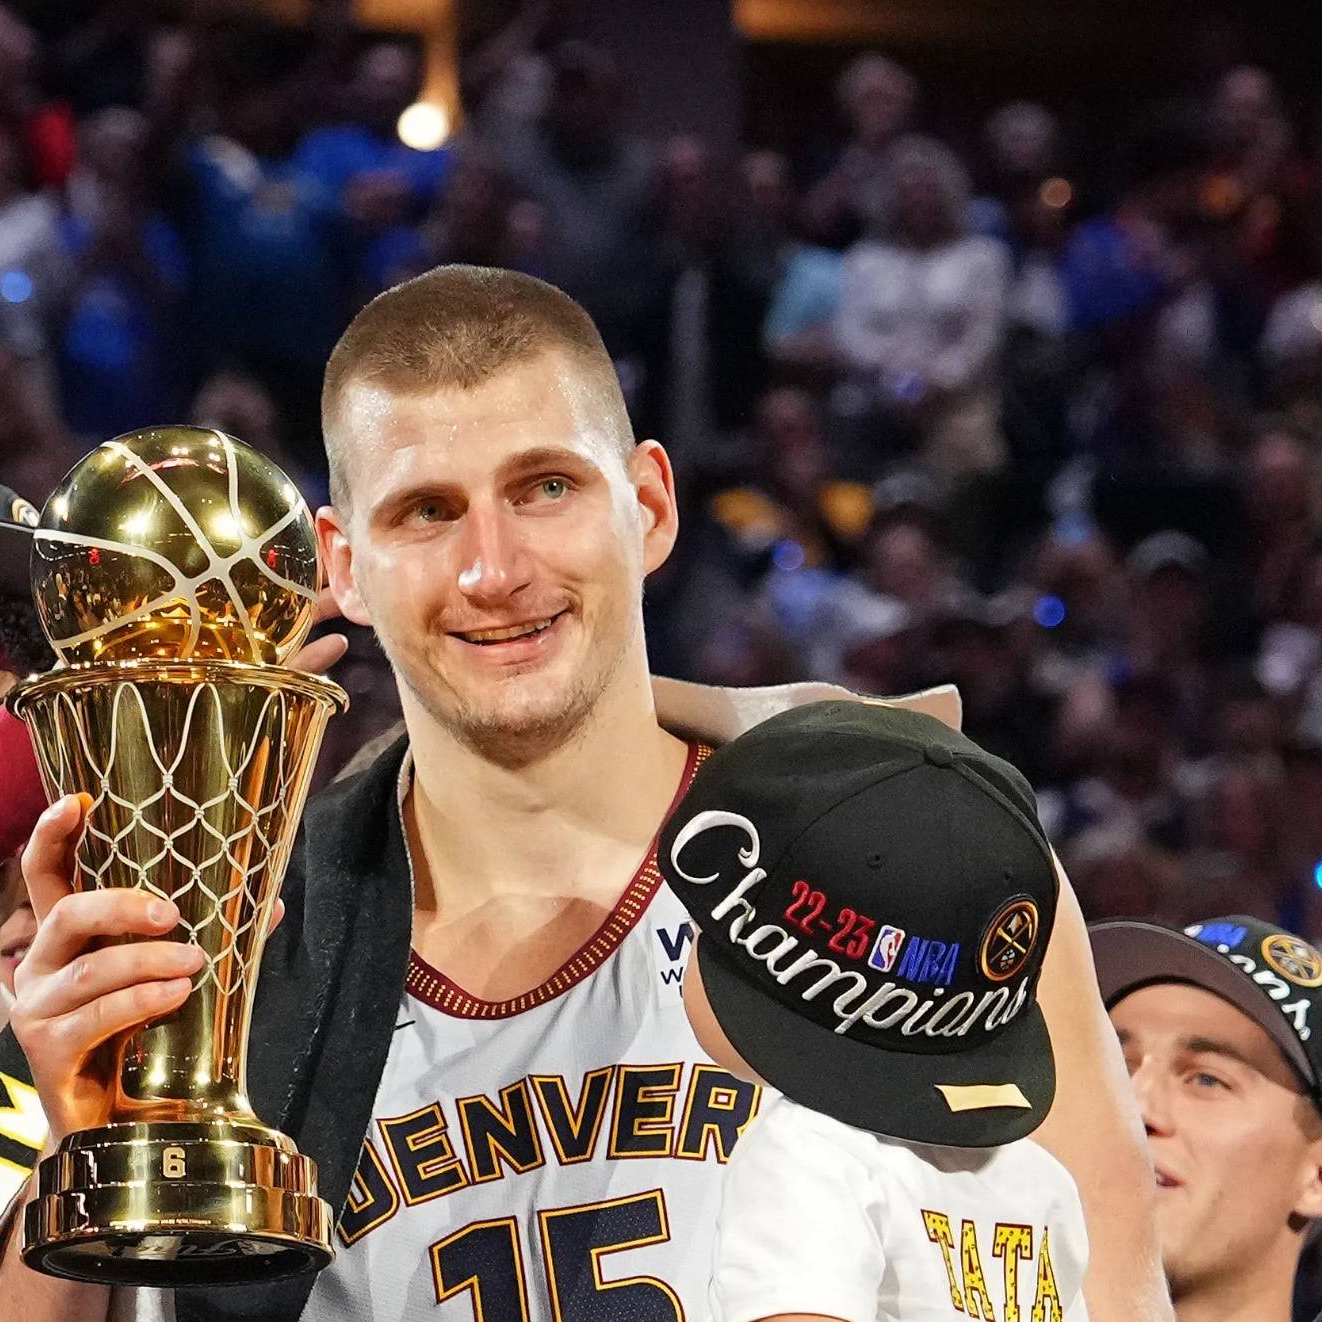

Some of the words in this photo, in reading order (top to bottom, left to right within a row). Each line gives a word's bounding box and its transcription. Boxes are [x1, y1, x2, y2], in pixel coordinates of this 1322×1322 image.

[670, 809, 1029, 1036] Champions
[784, 879, 877, 961] 22-23
[896, 935, 960, 986] NBA
[161, 1146, 186, 1179] 6
